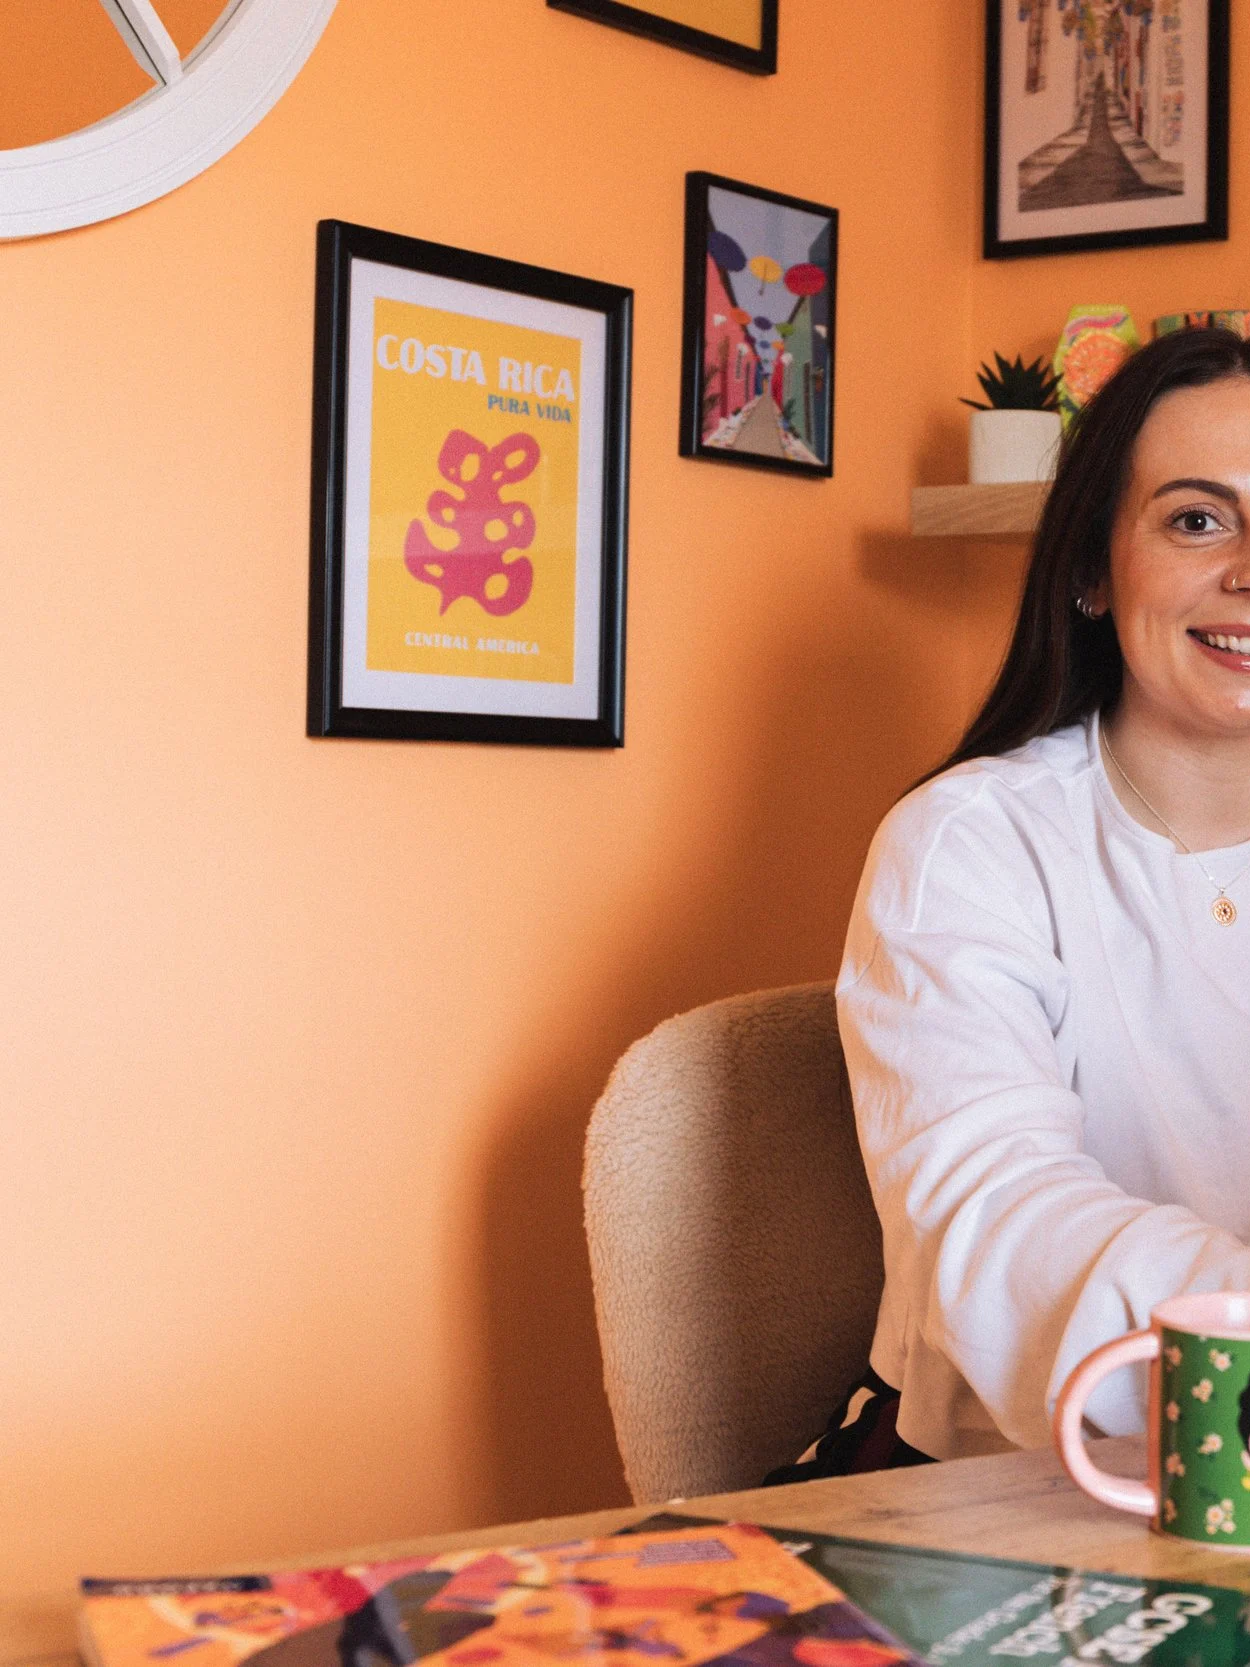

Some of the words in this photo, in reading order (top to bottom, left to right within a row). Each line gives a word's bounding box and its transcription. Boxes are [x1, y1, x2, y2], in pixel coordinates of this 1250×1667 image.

[376, 333, 487, 387] COSTA
[498, 355, 576, 404] RICA
[487, 393, 531, 417] PURA
[536, 402, 573, 424] VIDA
[404, 631, 470, 651] CENTRAL
[475, 636, 541, 656] AMERICA
